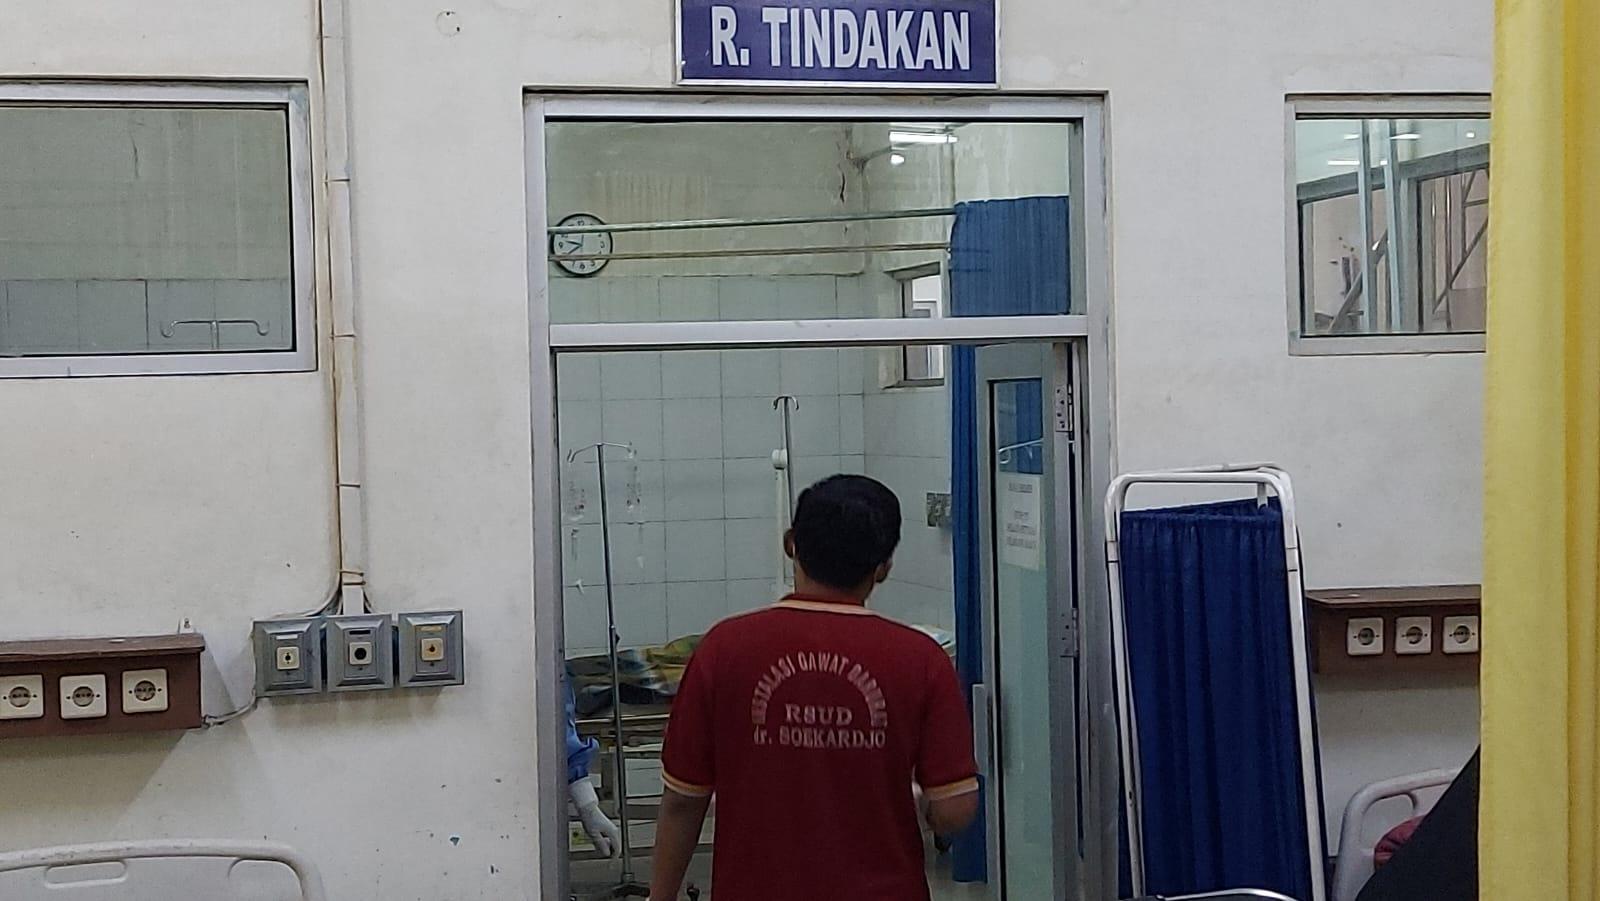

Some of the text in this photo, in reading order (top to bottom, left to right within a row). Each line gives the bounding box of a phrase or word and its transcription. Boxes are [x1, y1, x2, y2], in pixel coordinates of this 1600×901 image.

[711, 6, 970, 70] R. TINDAKAN
[751, 654, 796, 725] STALASI
[797, 651, 849, 676] GAWAT
[785, 703, 853, 726] RSUD
[779, 725, 886, 749] SOEKARDJO
